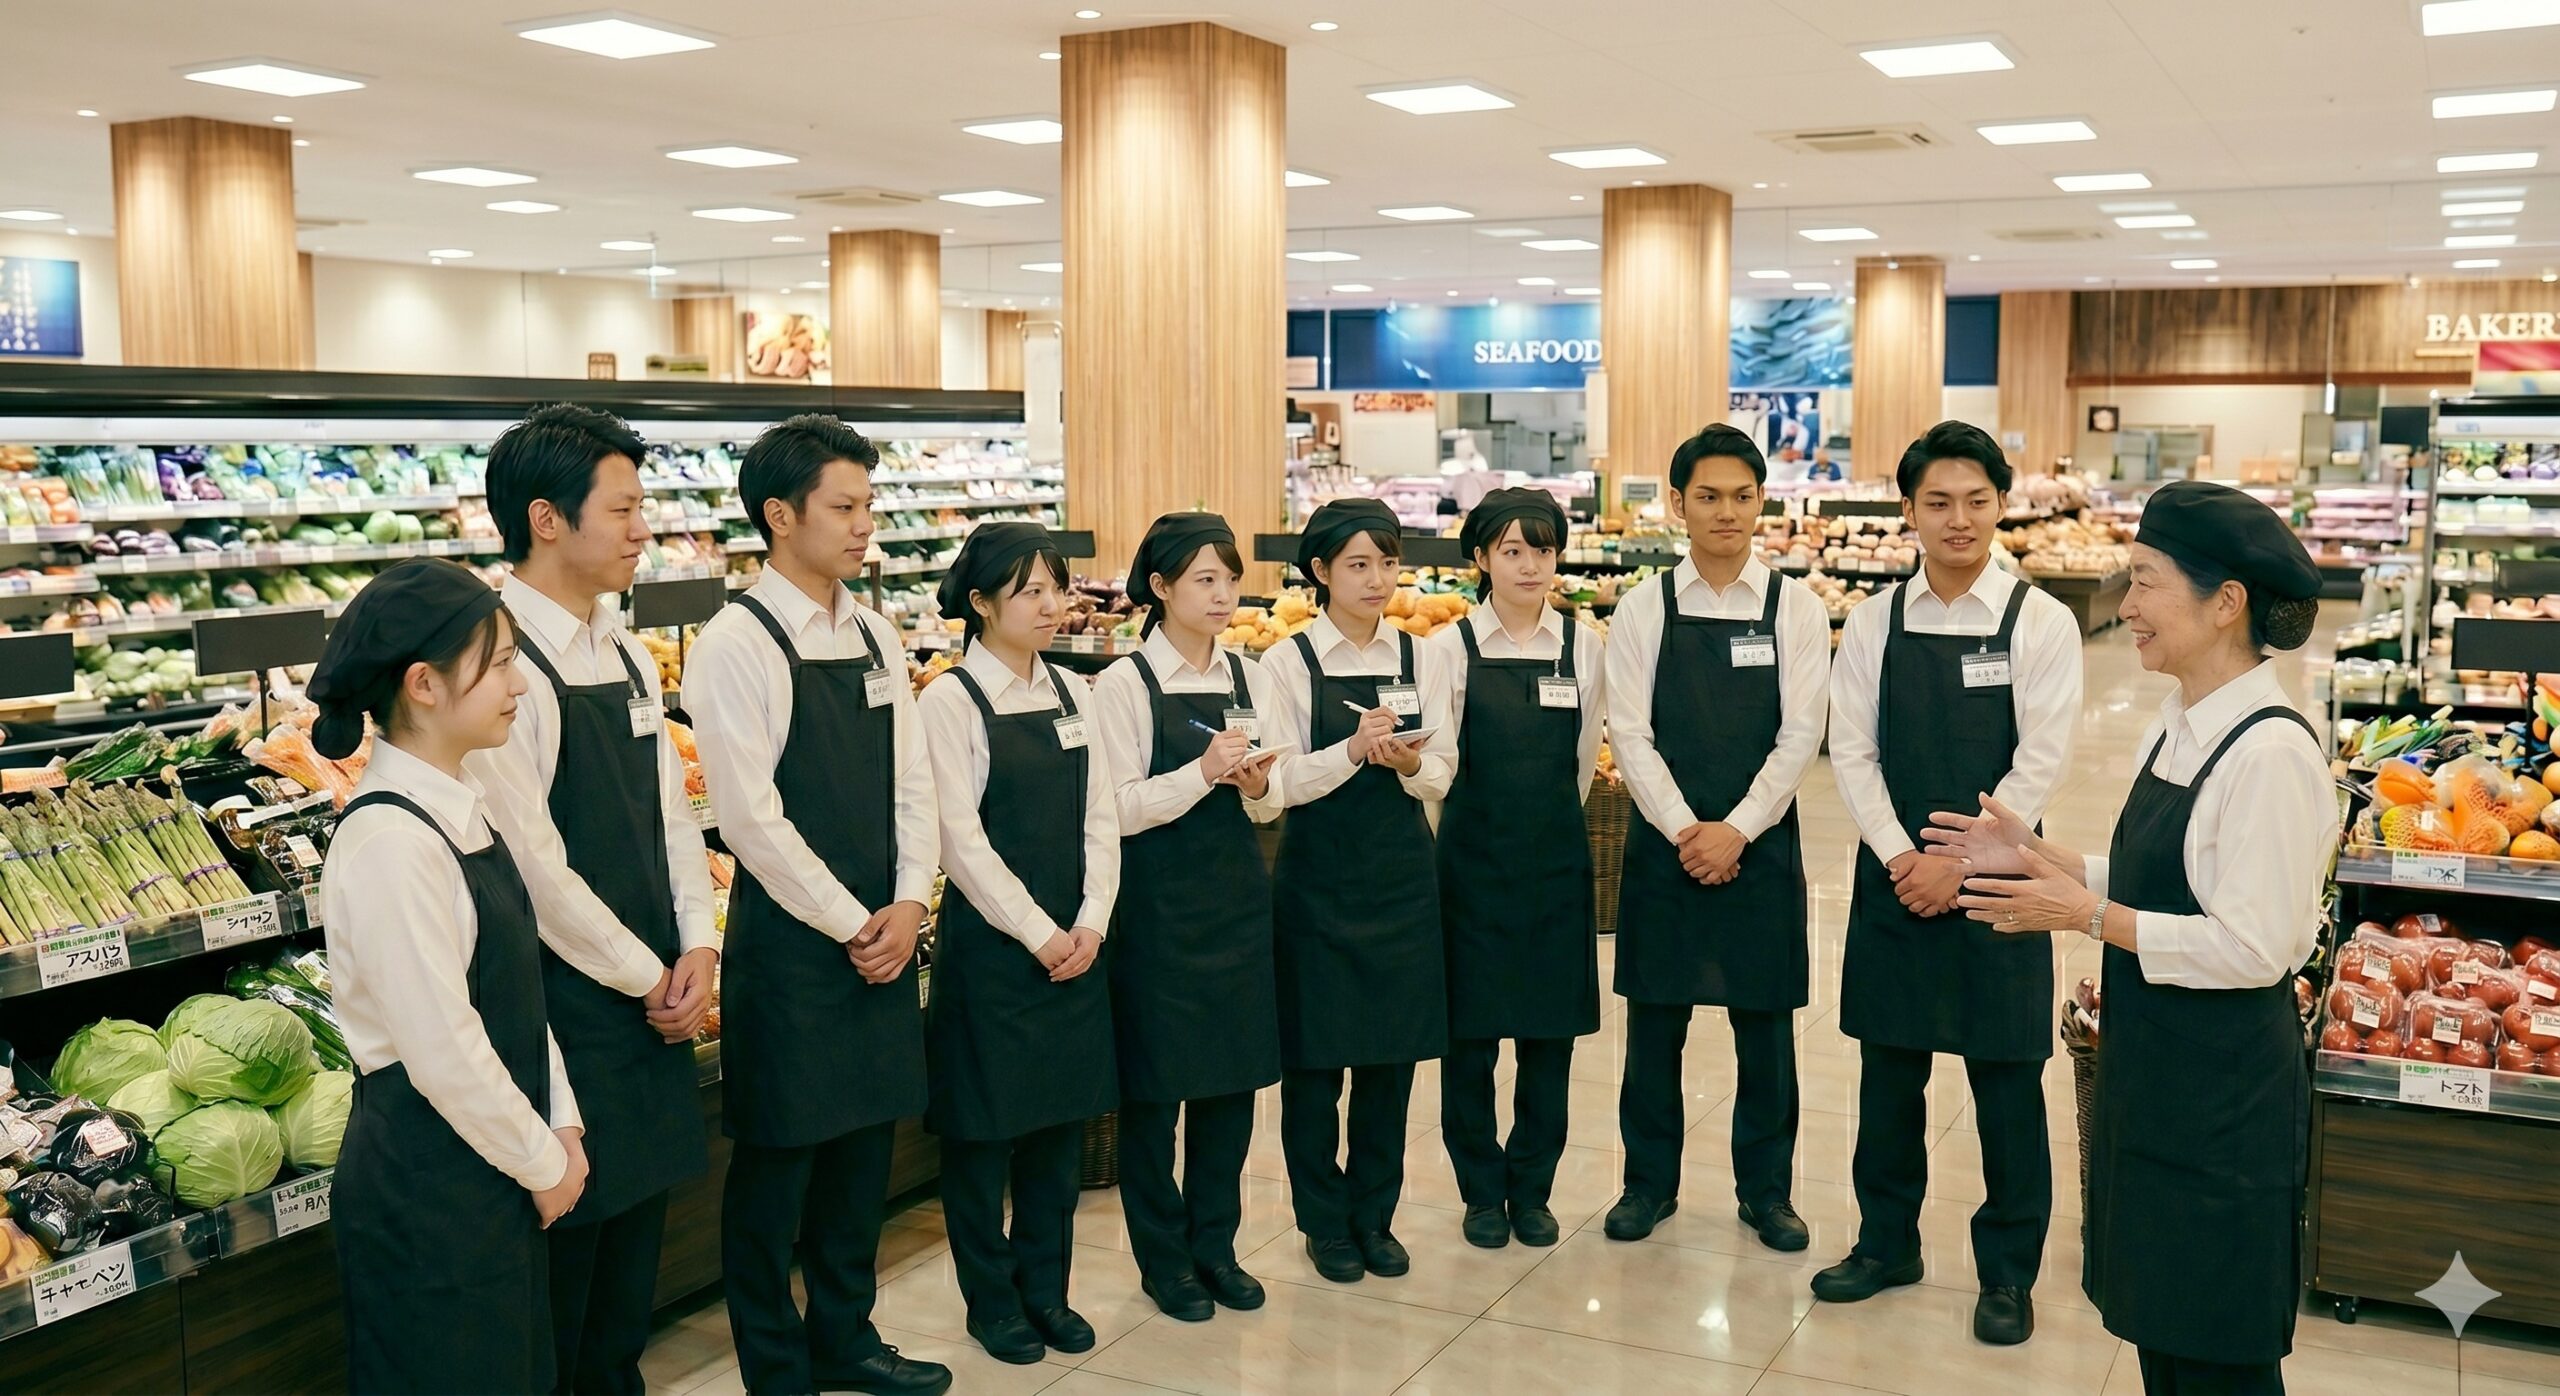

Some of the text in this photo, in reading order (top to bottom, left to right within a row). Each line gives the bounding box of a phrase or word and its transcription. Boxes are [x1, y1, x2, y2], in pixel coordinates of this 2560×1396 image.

[2425, 312, 2560, 342] BAKER
[1474, 339, 1602, 363] SEAFOOD
[2441, 1080, 2483, 1096] トマト
